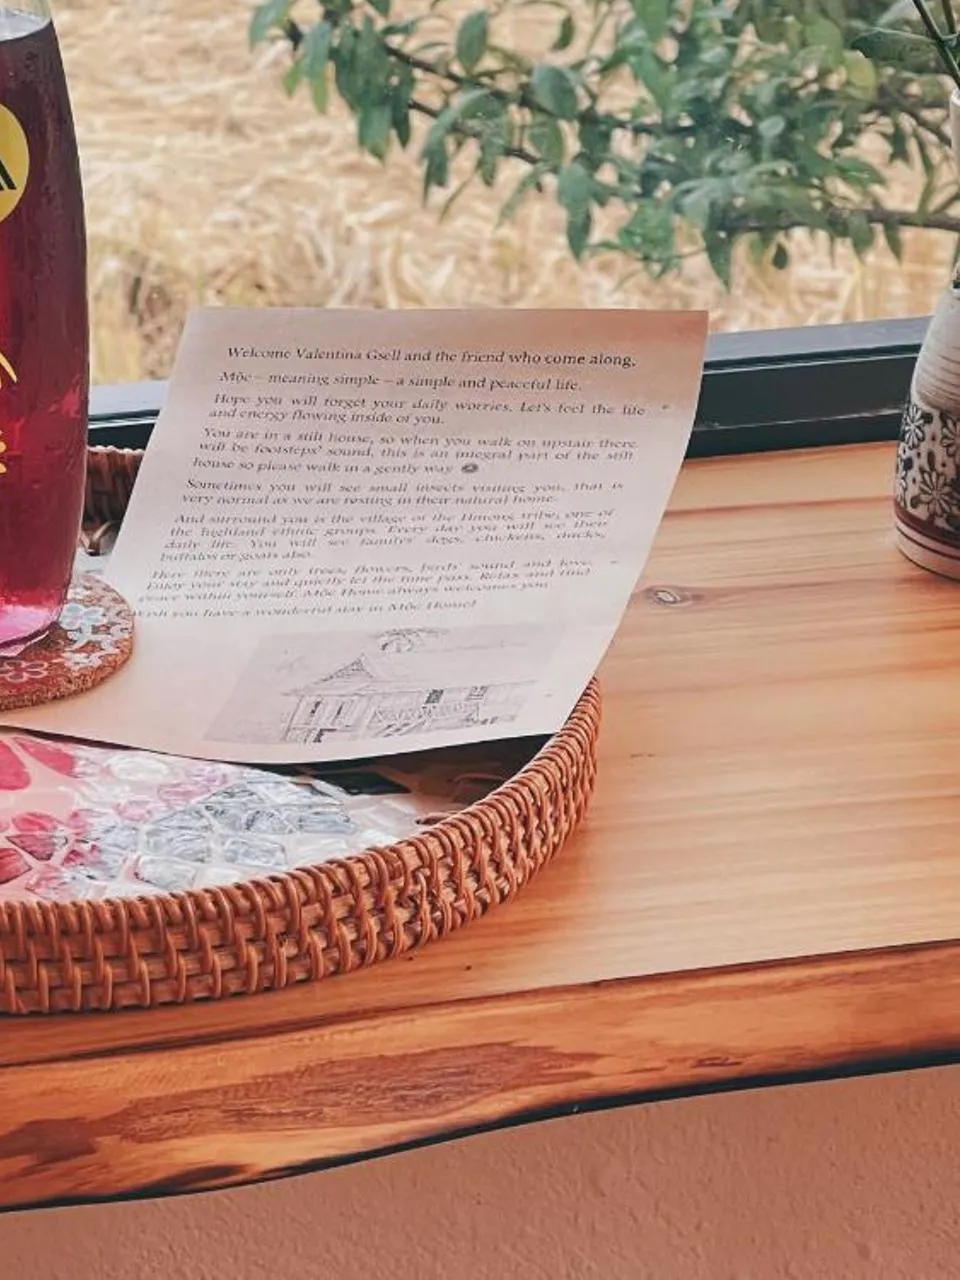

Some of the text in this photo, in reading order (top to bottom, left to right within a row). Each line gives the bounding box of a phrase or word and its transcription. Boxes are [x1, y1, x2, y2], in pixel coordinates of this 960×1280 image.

[228, 347, 637, 369] Welcome Valentina Gsell and the friend who come along,
[268, 375, 329, 386] meaning
[333, 375, 379, 388] simple
[396, 378, 404, 387] a
[408, 377, 454, 389] simple
[458, 378, 486, 389] and
[490, 378, 551, 391] peaceful
[556, 379, 582, 391] life.
[214, 394, 249, 406] Hope
[257, 397, 282, 406] you
[292, 396, 317, 406] will
[324, 397, 365, 409] forget
[373, 399, 404, 409] your
[412, 399, 448, 410] daily
[455, 402, 513, 413] worries.
[558, 403, 584, 414] feel
[592, 403, 613, 415] the
[623, 404, 645, 416] life
[209, 408, 236, 418] and
[240, 410, 286, 421] energy
[292, 410, 346, 423] flowing
[351, 412, 392, 423] inside
[396, 413, 412, 423] of
[236, 431, 259, 439] are
[265, 431, 278, 439] in
[299, 431, 322, 441] still
[380, 436, 394, 444] so
[401, 435, 439, 445] when
[445, 437, 471, 447] you
[478, 437, 512, 447] walk
